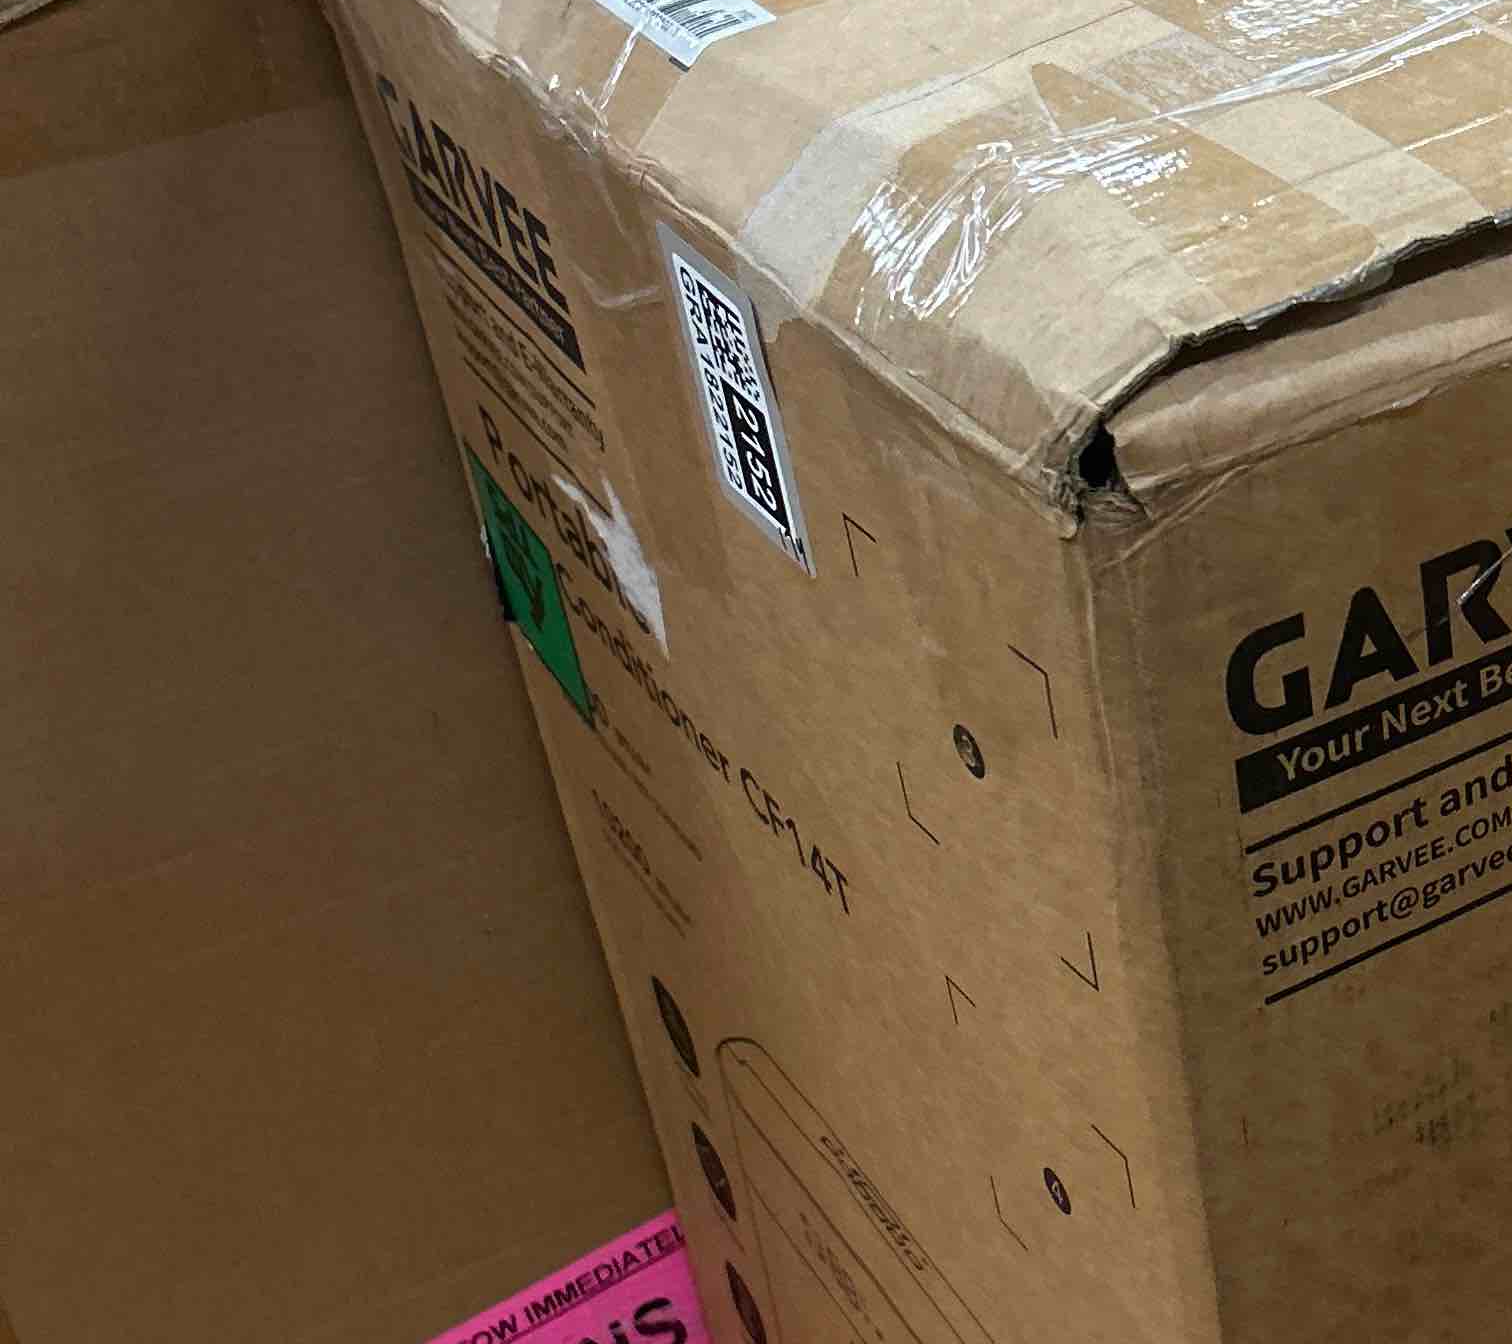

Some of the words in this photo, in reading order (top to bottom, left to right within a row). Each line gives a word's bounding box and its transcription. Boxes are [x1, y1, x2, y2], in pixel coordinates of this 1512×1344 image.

[732, 387, 777, 512] 2152
[1276, 724, 1372, 784] Your
[1380, 678, 1470, 740] Next
[1251, 796, 1429, 898] Support
[524, 1223, 687, 1325] IMMEDIATEL
